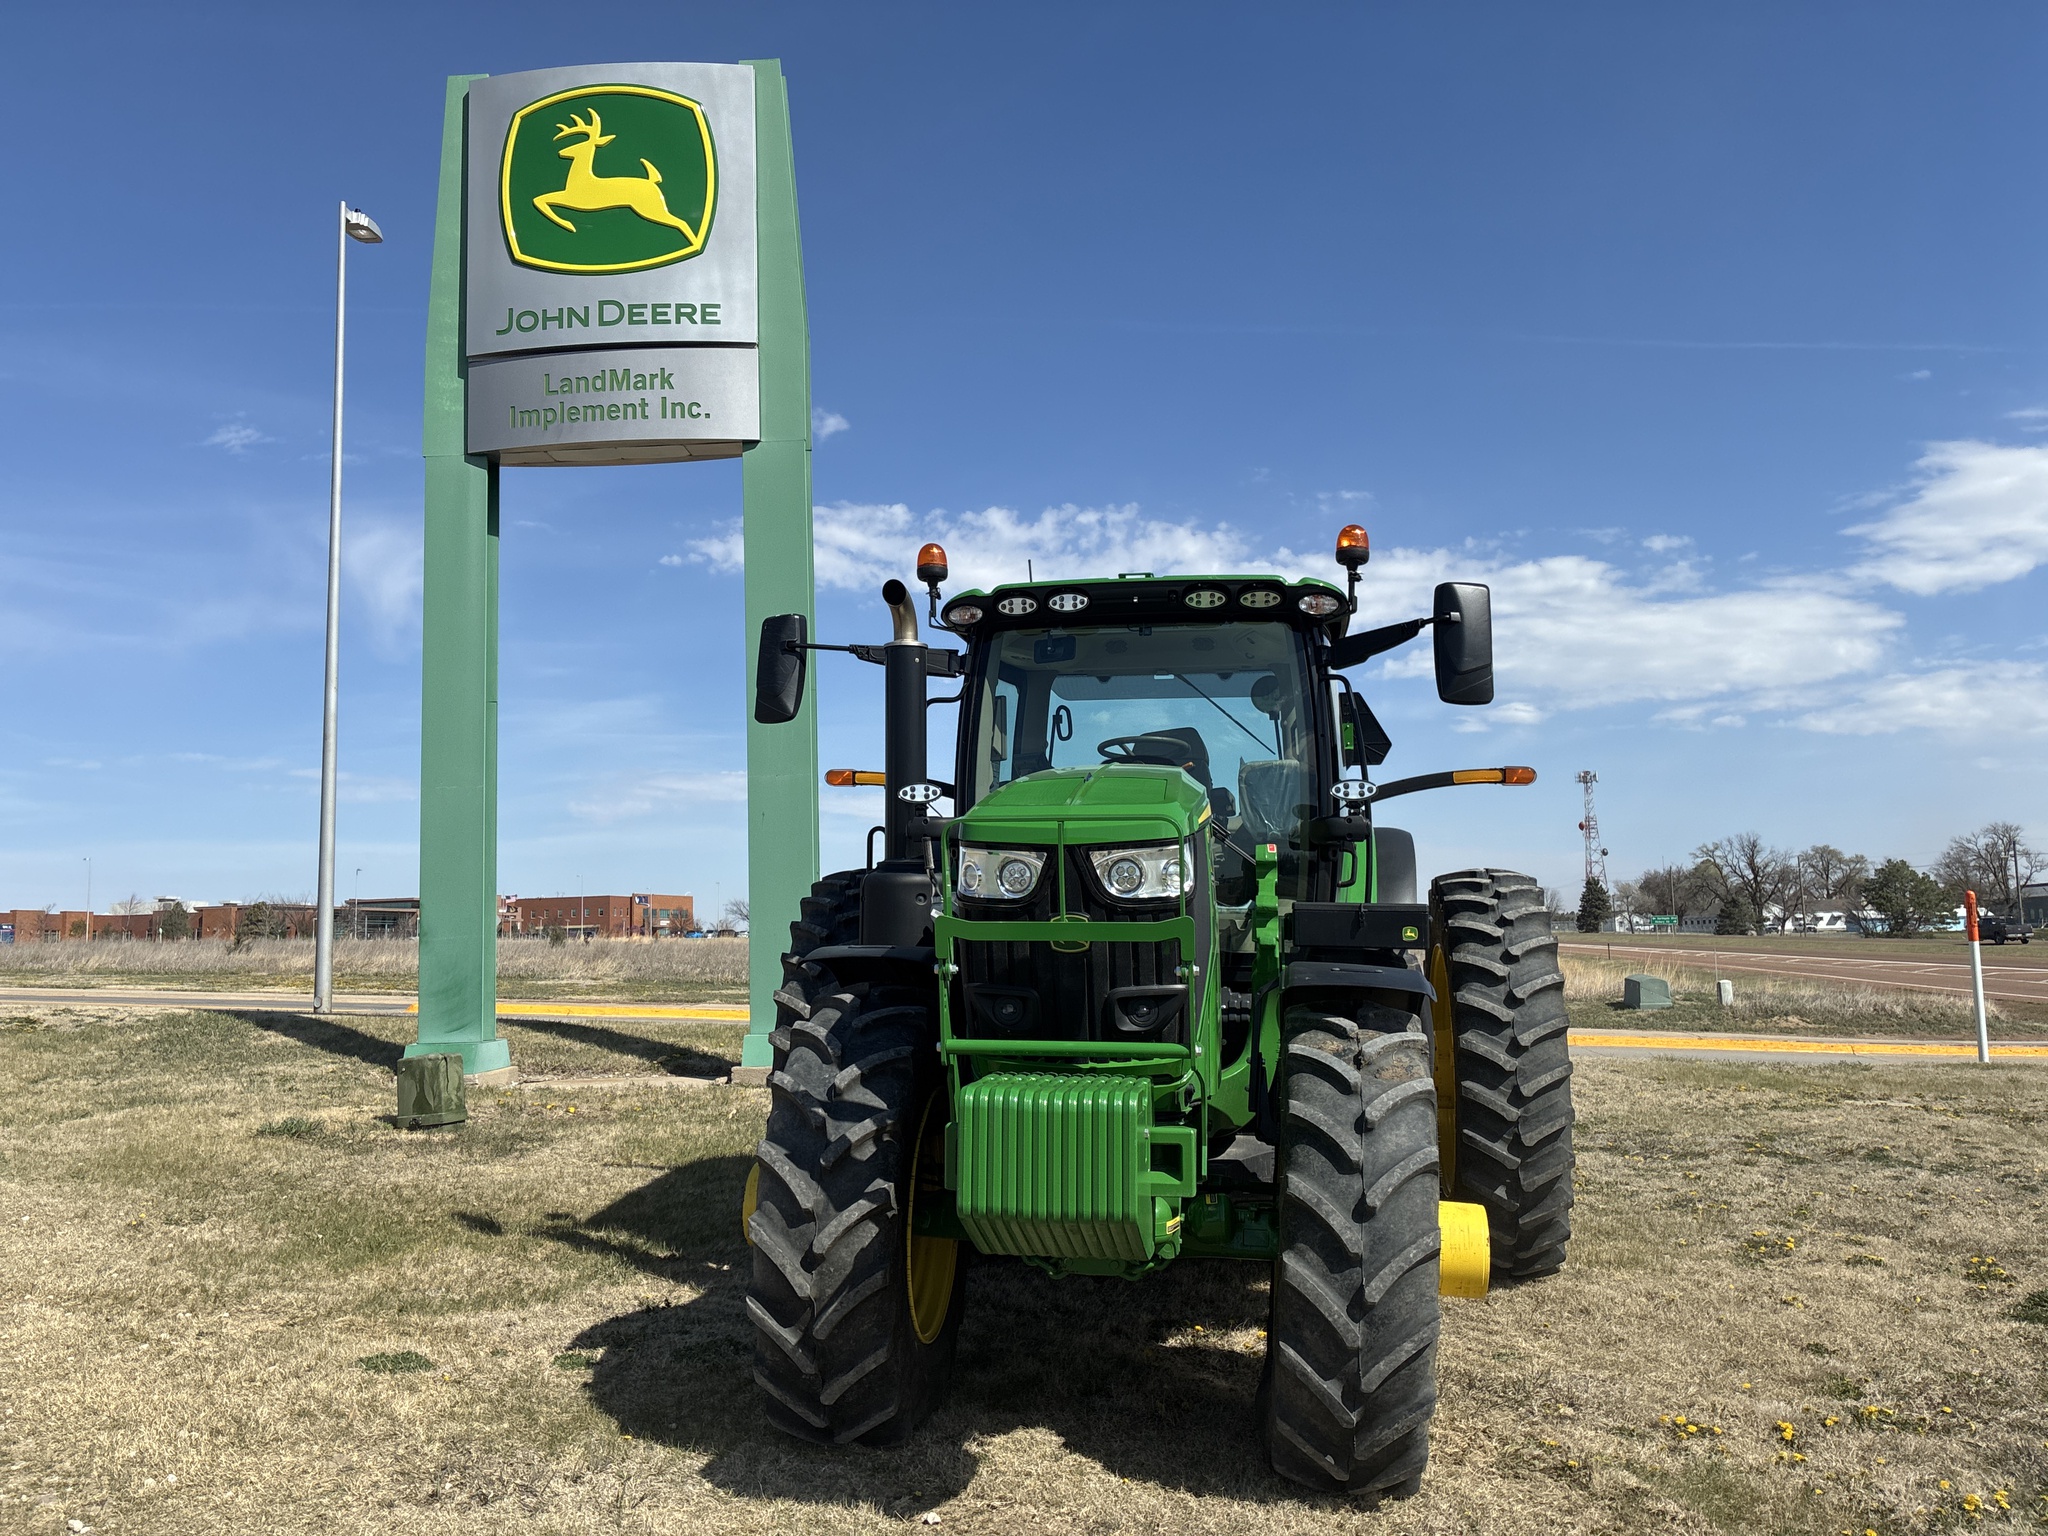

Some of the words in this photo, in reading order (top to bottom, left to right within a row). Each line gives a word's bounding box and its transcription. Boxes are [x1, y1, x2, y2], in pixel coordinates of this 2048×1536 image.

[495, 305, 590, 336] JOHN
[597, 299, 722, 327] DEERE
[544, 367, 675, 396] LandMark
[509, 397, 649, 431] Implement
[660, 396, 711, 420] Inc.
